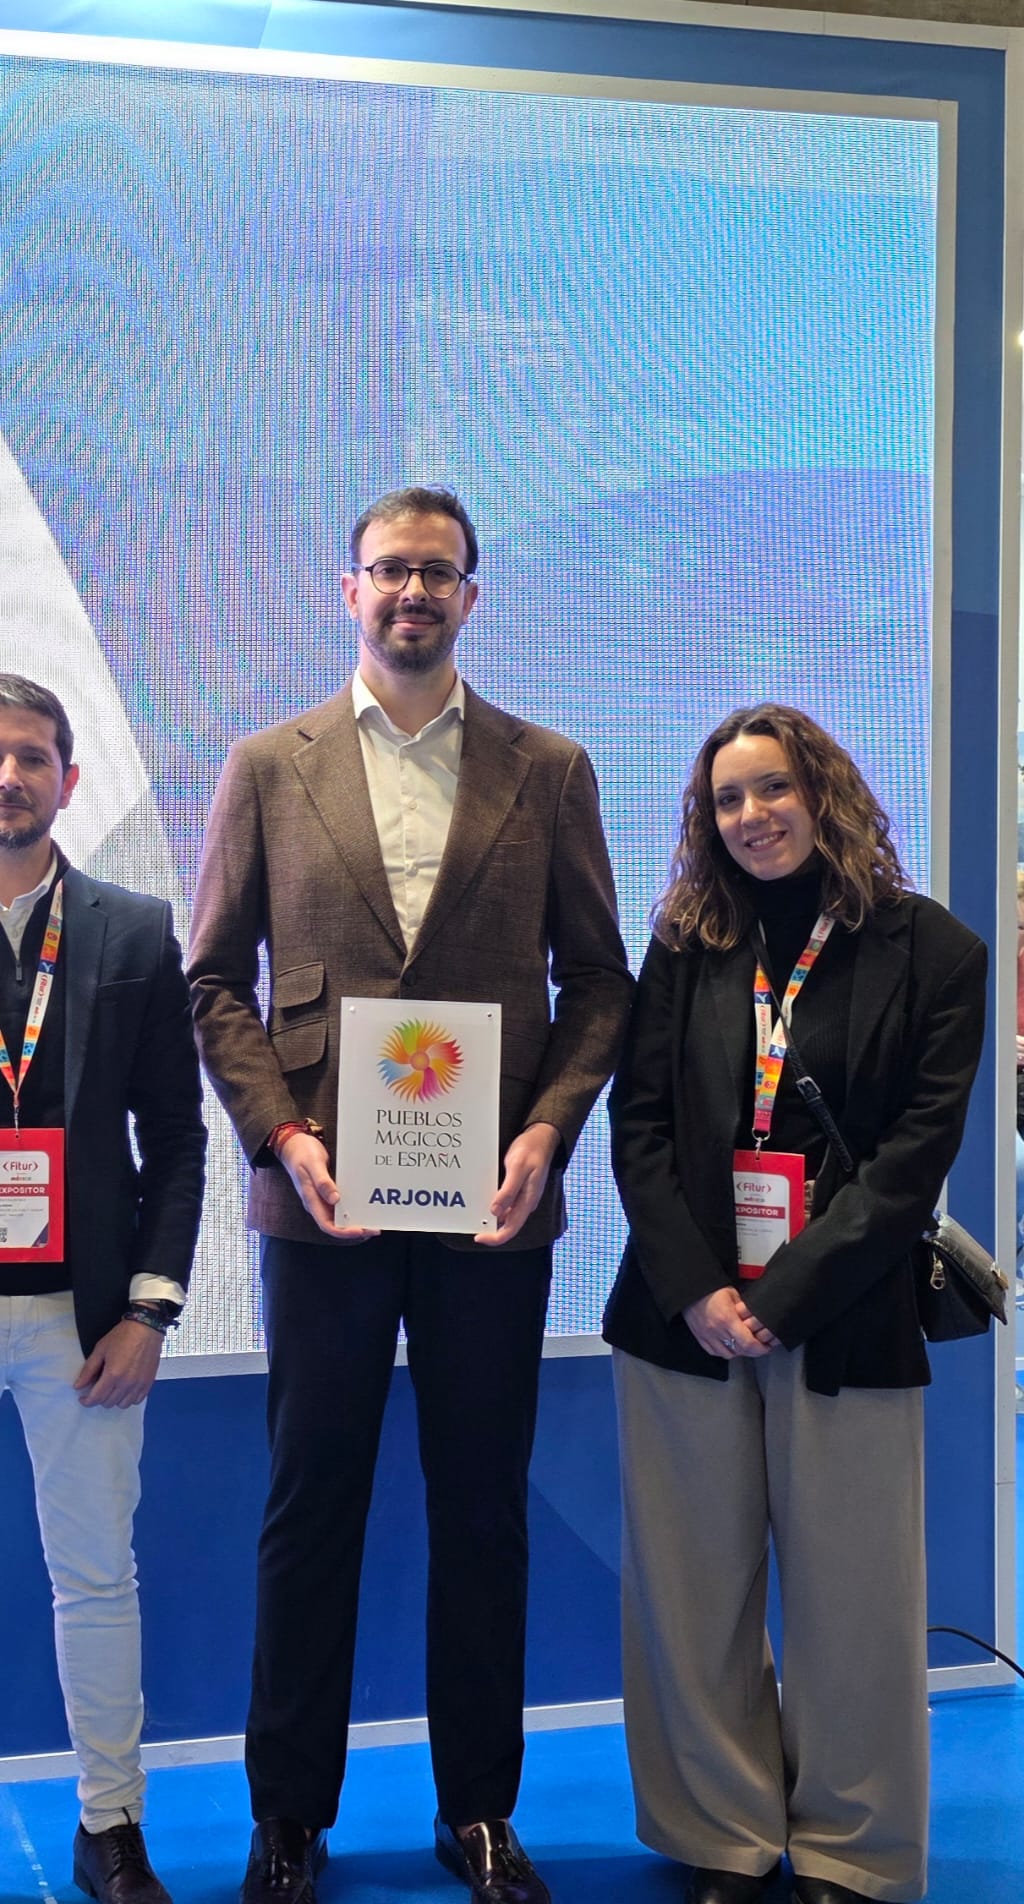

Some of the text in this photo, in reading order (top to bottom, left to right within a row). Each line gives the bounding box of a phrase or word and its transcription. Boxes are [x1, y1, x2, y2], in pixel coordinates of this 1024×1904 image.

[376, 1110, 462, 1127] PUEBLOS
[375, 1130, 462, 1148] MÁGICOS
[10, 1161, 32, 1171] Fitur
[375, 1152, 461, 1168] DE ESPAÑA
[743, 1183, 765, 1192] Fitur
[369, 1188, 466, 1207] ARJONA
[736, 1207, 778, 1216] XPOSITOR
